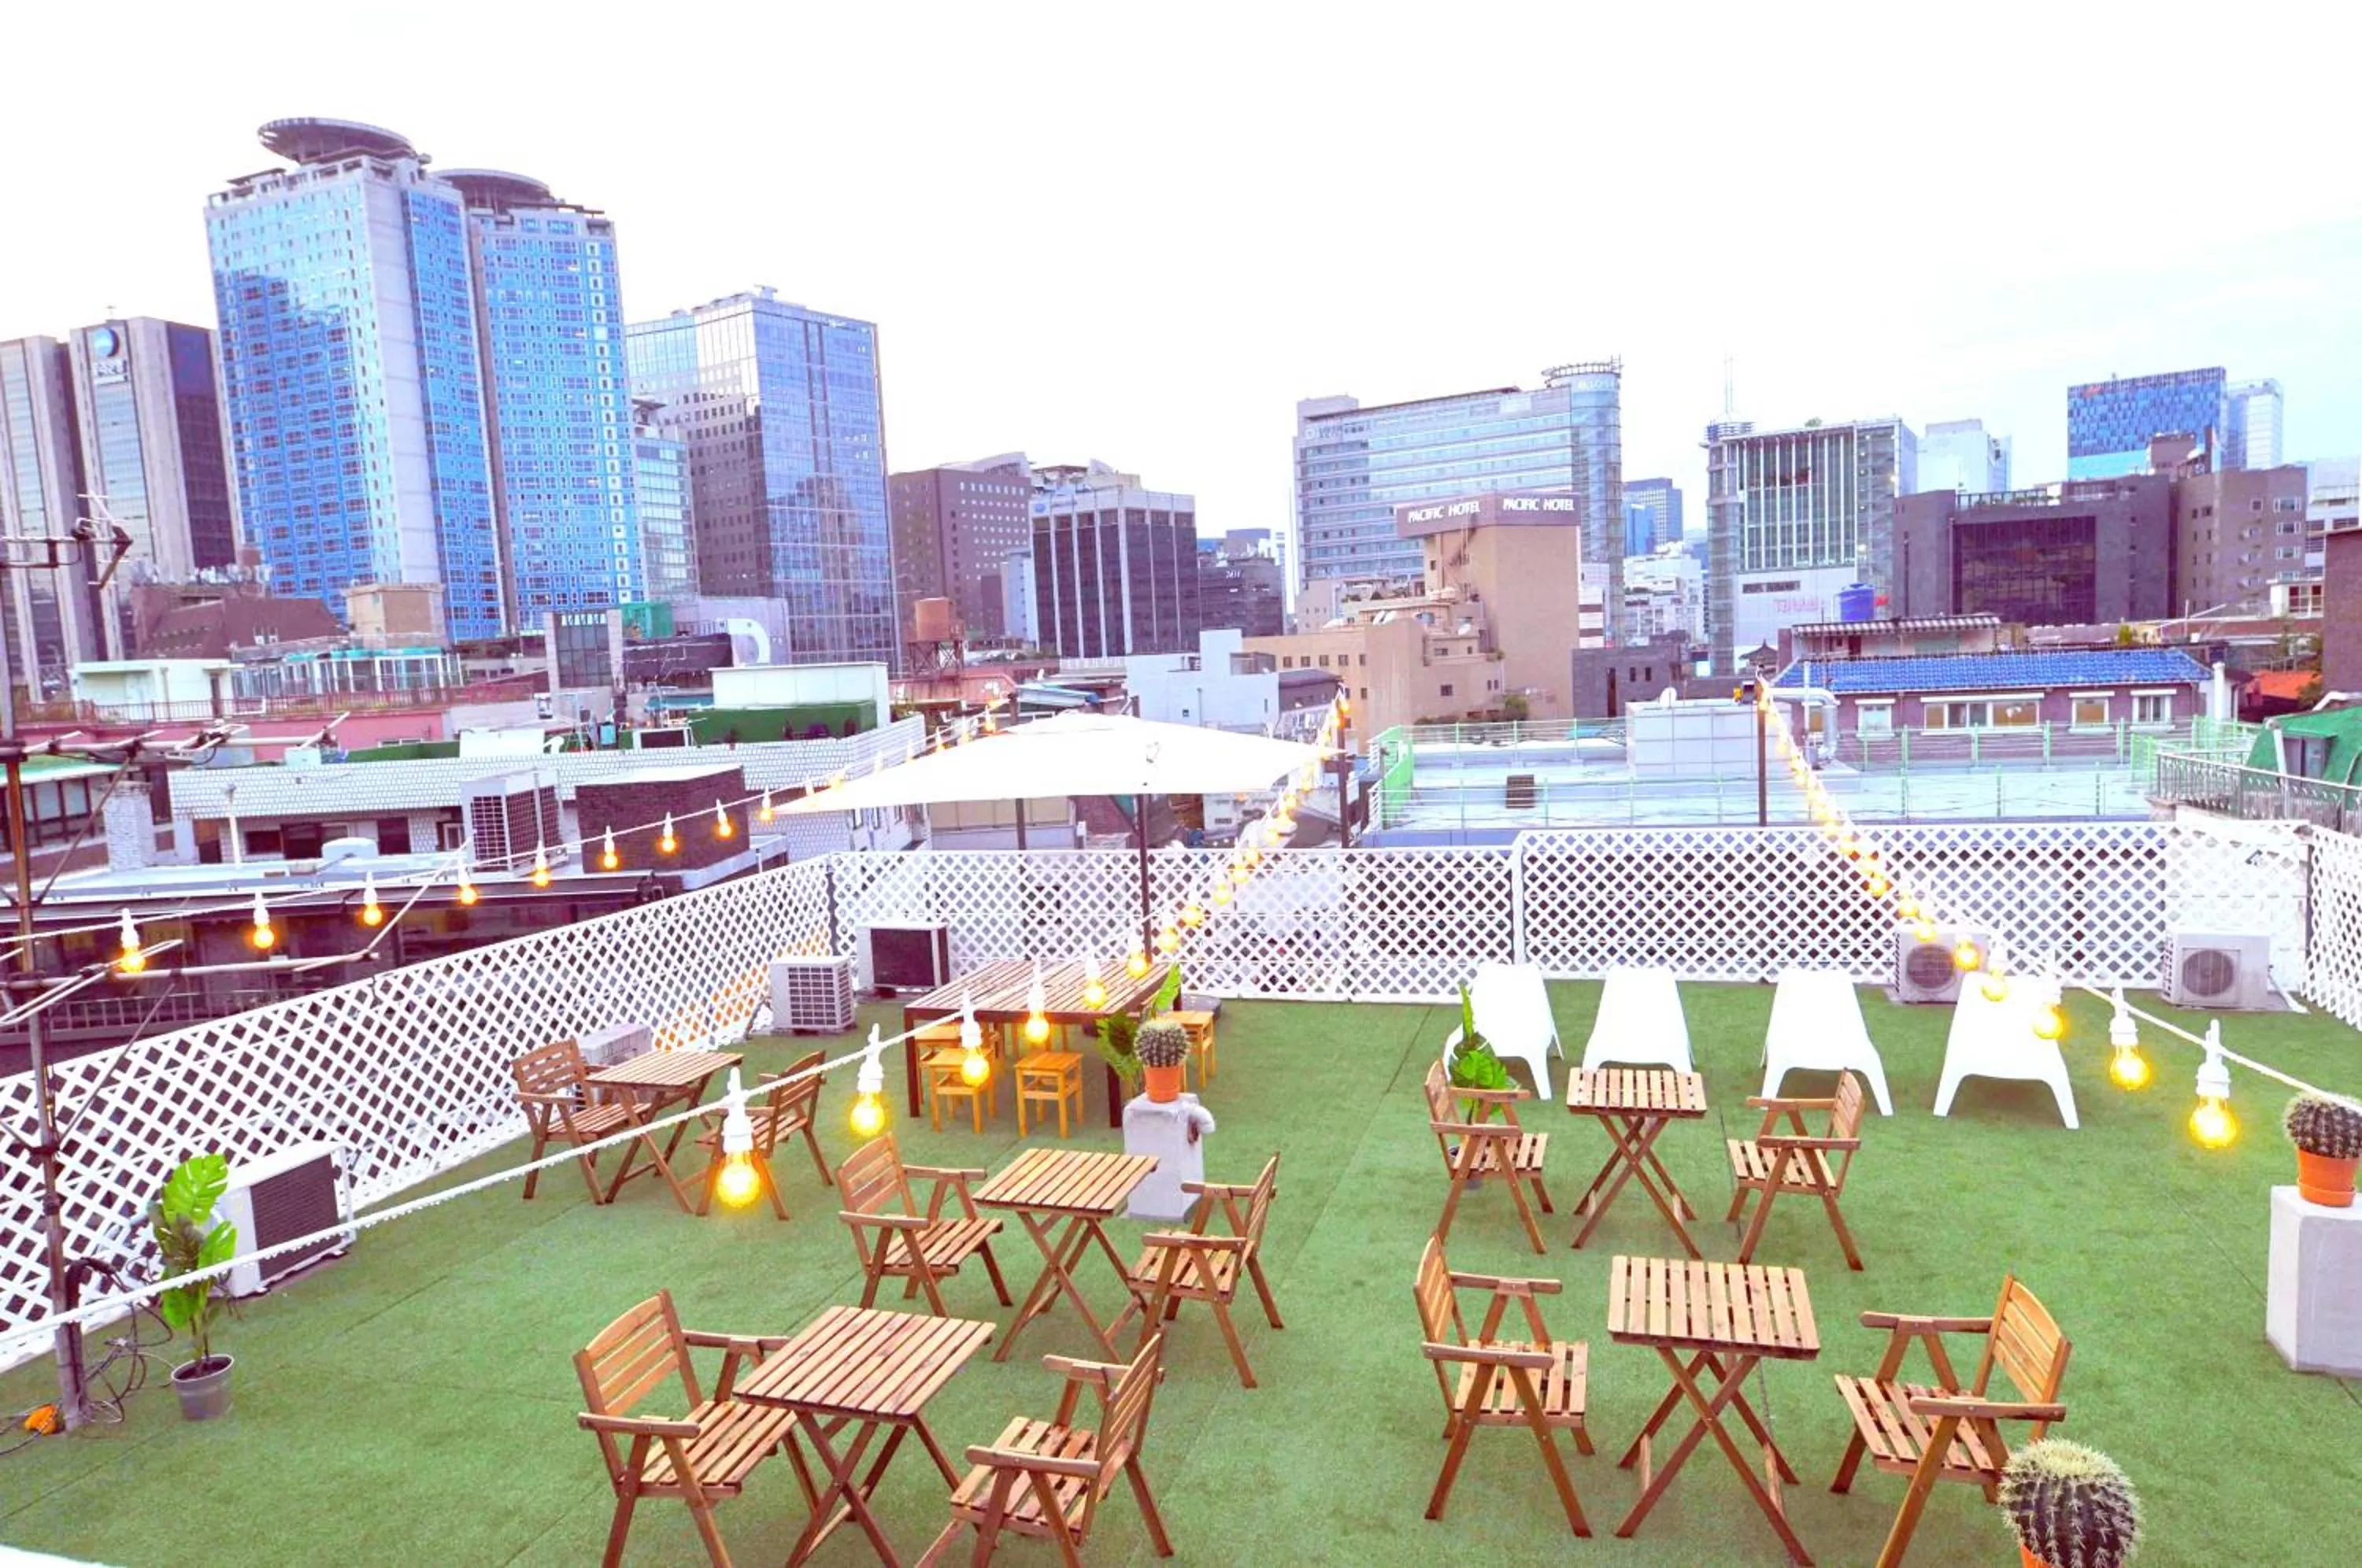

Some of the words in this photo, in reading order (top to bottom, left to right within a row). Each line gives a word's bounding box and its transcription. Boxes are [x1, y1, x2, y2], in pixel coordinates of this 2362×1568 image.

[1408, 506, 1444, 523] PACIFIC
[1448, 501, 1481, 516] HOTEL
[1503, 497, 1539, 511] PACIFIC
[1543, 498, 1575, 511] HOTEL
